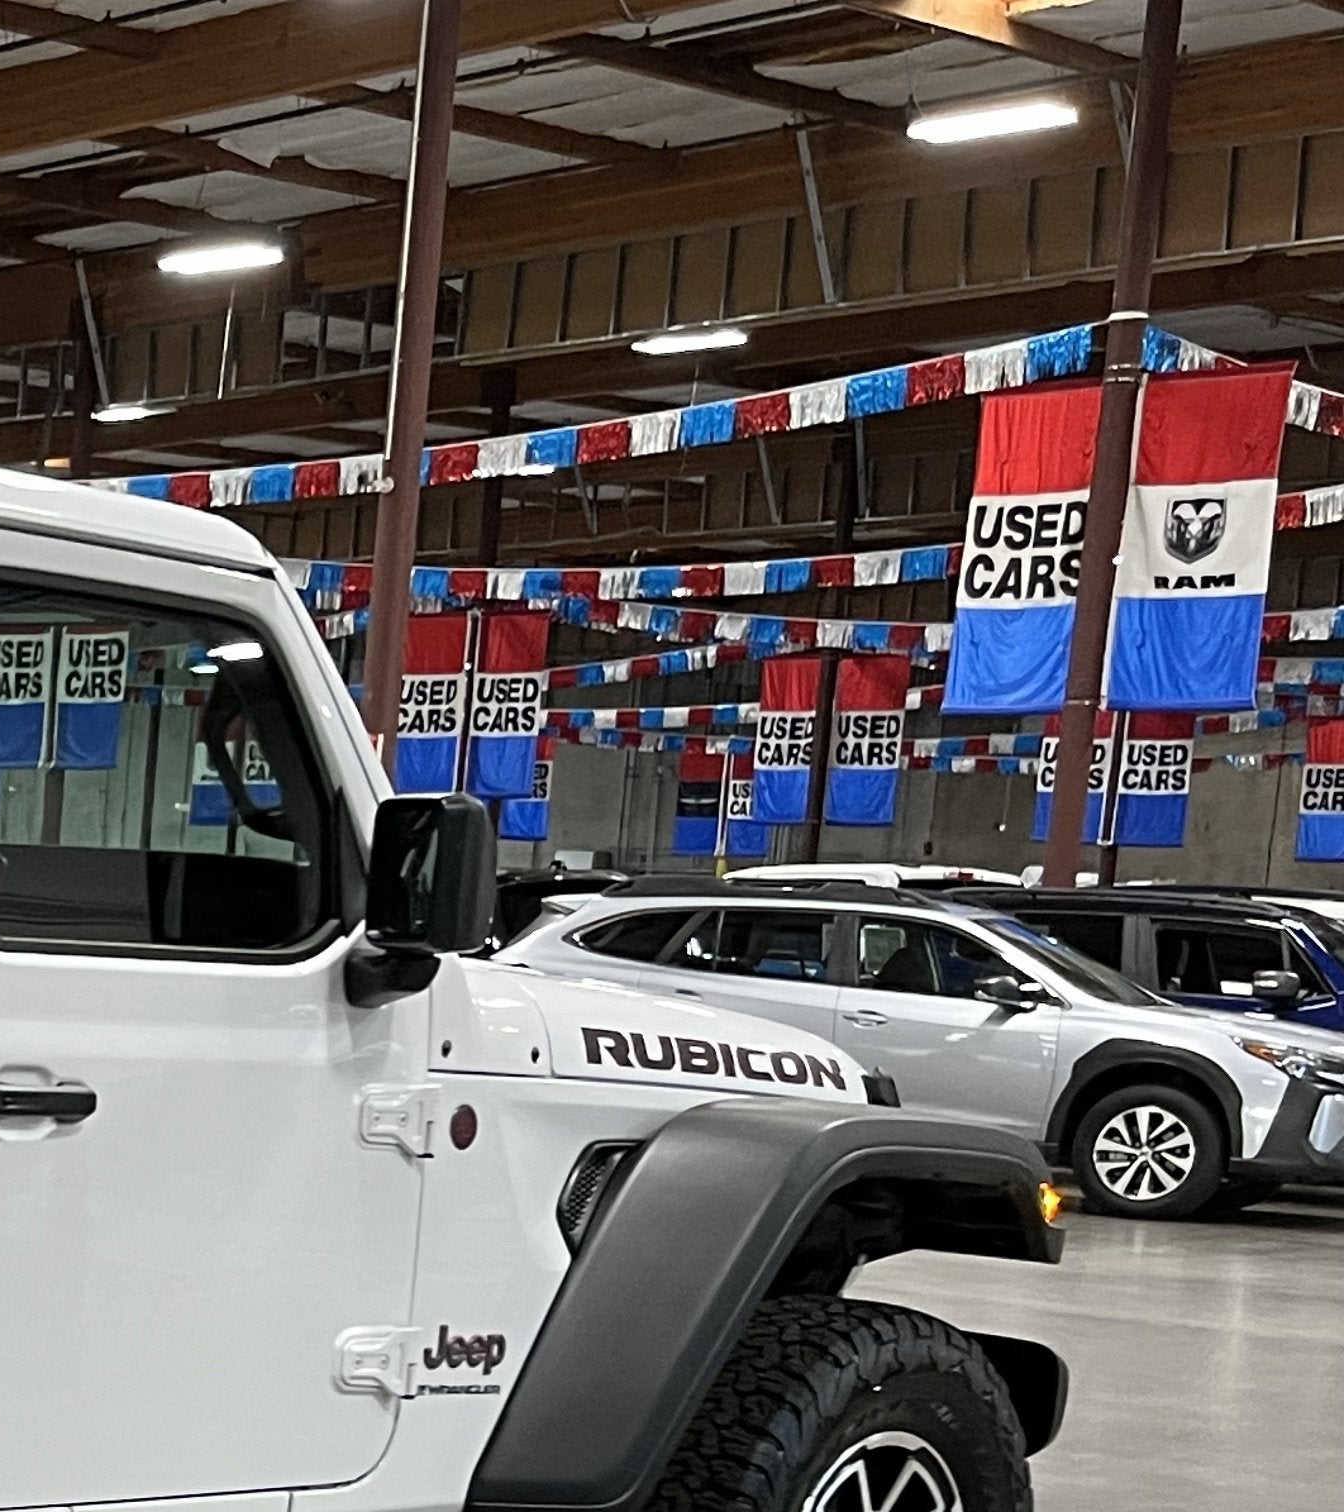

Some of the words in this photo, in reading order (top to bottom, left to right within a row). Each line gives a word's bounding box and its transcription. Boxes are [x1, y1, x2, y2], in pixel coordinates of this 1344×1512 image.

[973, 500, 1088, 551] USED
[964, 550, 1083, 600] CARS
[1153, 573, 1236, 590] RAM
[65, 669, 122, 699] CARS
[401, 679, 458, 706] USED
[477, 677, 540, 704] USED
[397, 706, 457, 734] CARS
[472, 706, 537, 733] CARS
[760, 715, 816, 740] USED
[837, 715, 901, 740] USED
[757, 741, 813, 767] CARS
[835, 741, 899, 766] CARS
[1043, 742, 1106, 765] UD
[1127, 743, 1189, 767] USED
[732, 782, 751, 799] US
[1040, 766, 1105, 790] CS
[1121, 768, 1187, 791] CARS
[1305, 768, 1344, 789] USE
[729, 800, 752, 816] CA
[1302, 791, 1344, 811] CAR
[581, 1027, 847, 1091] RUBICON
[423, 1324, 506, 1376] Jeep
